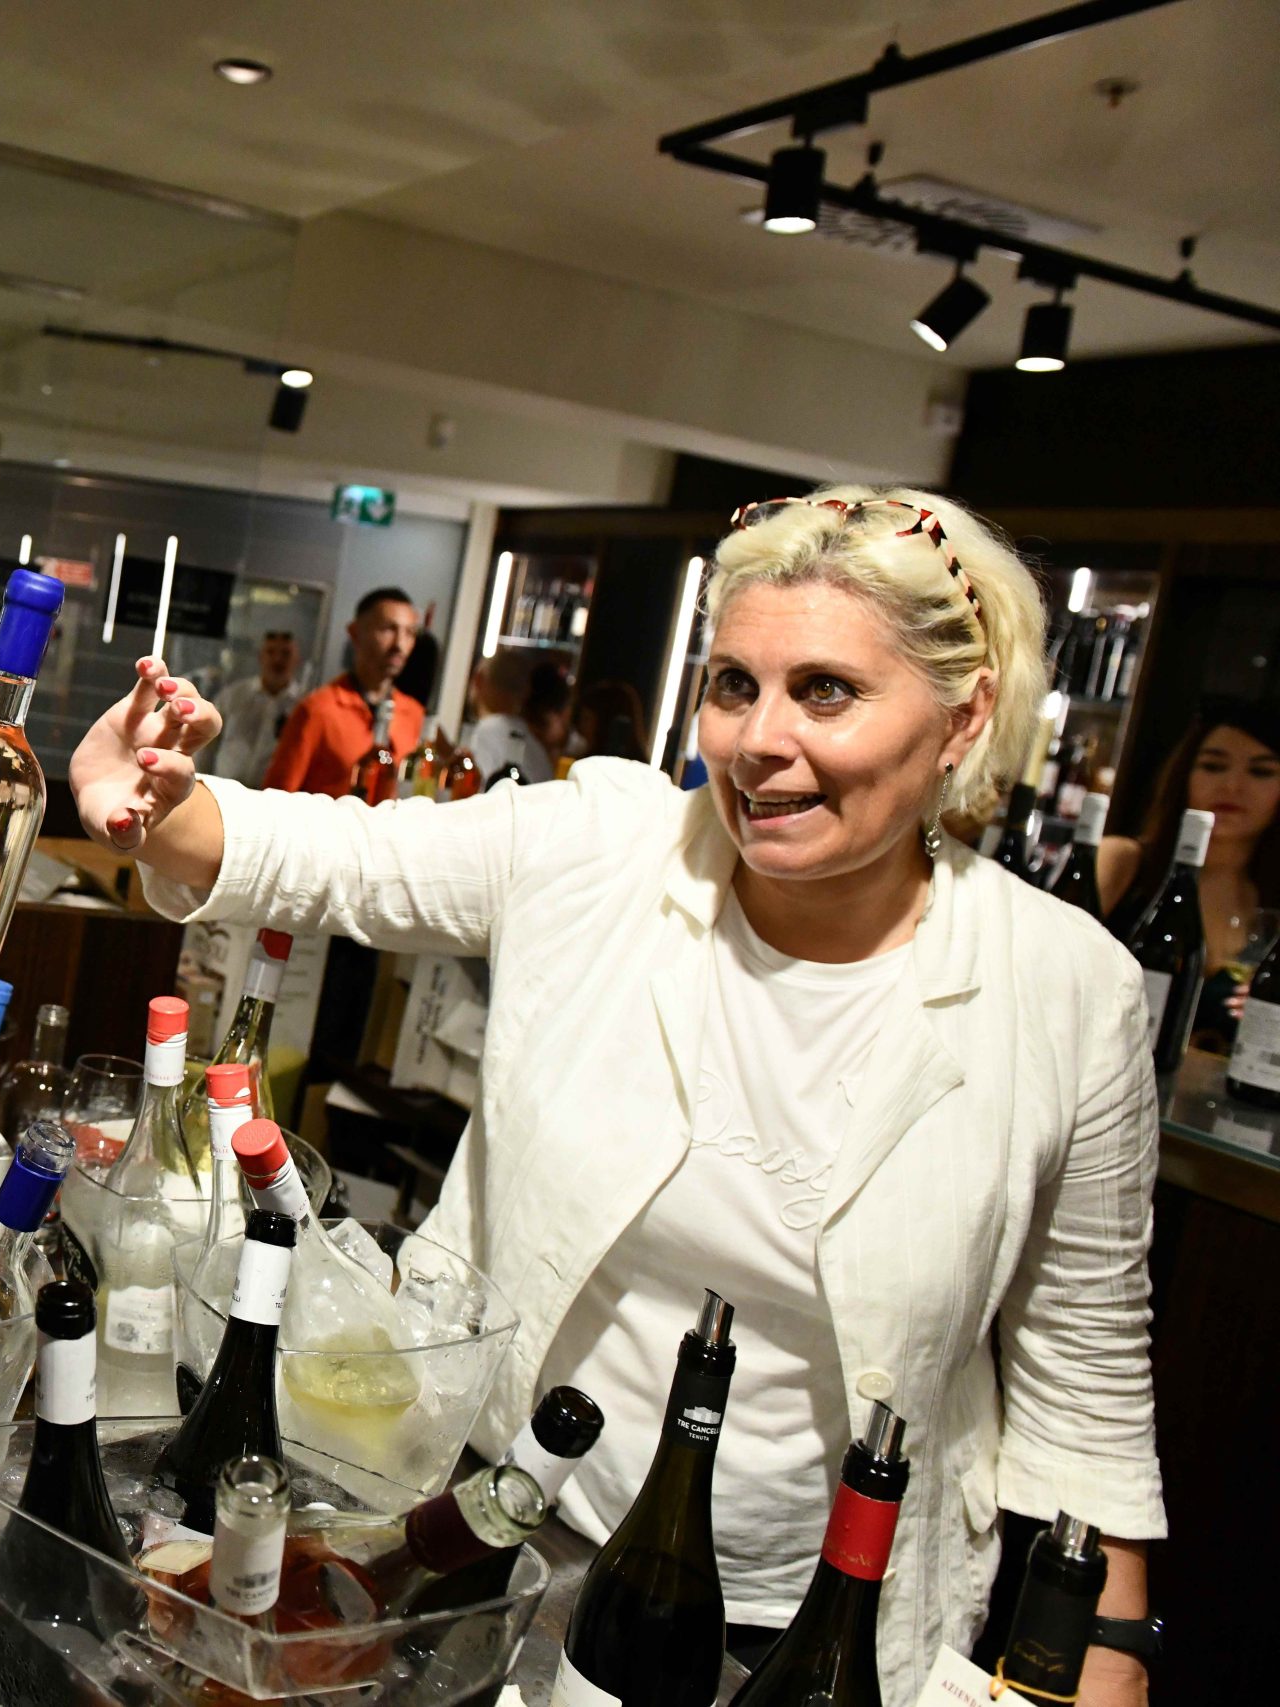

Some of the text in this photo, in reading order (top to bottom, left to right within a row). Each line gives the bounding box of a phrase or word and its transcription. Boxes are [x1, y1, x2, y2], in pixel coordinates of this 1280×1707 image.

[677, 1418, 721, 1435] TRE CANCELL
[689, 1432, 710, 1442] TENUTA
